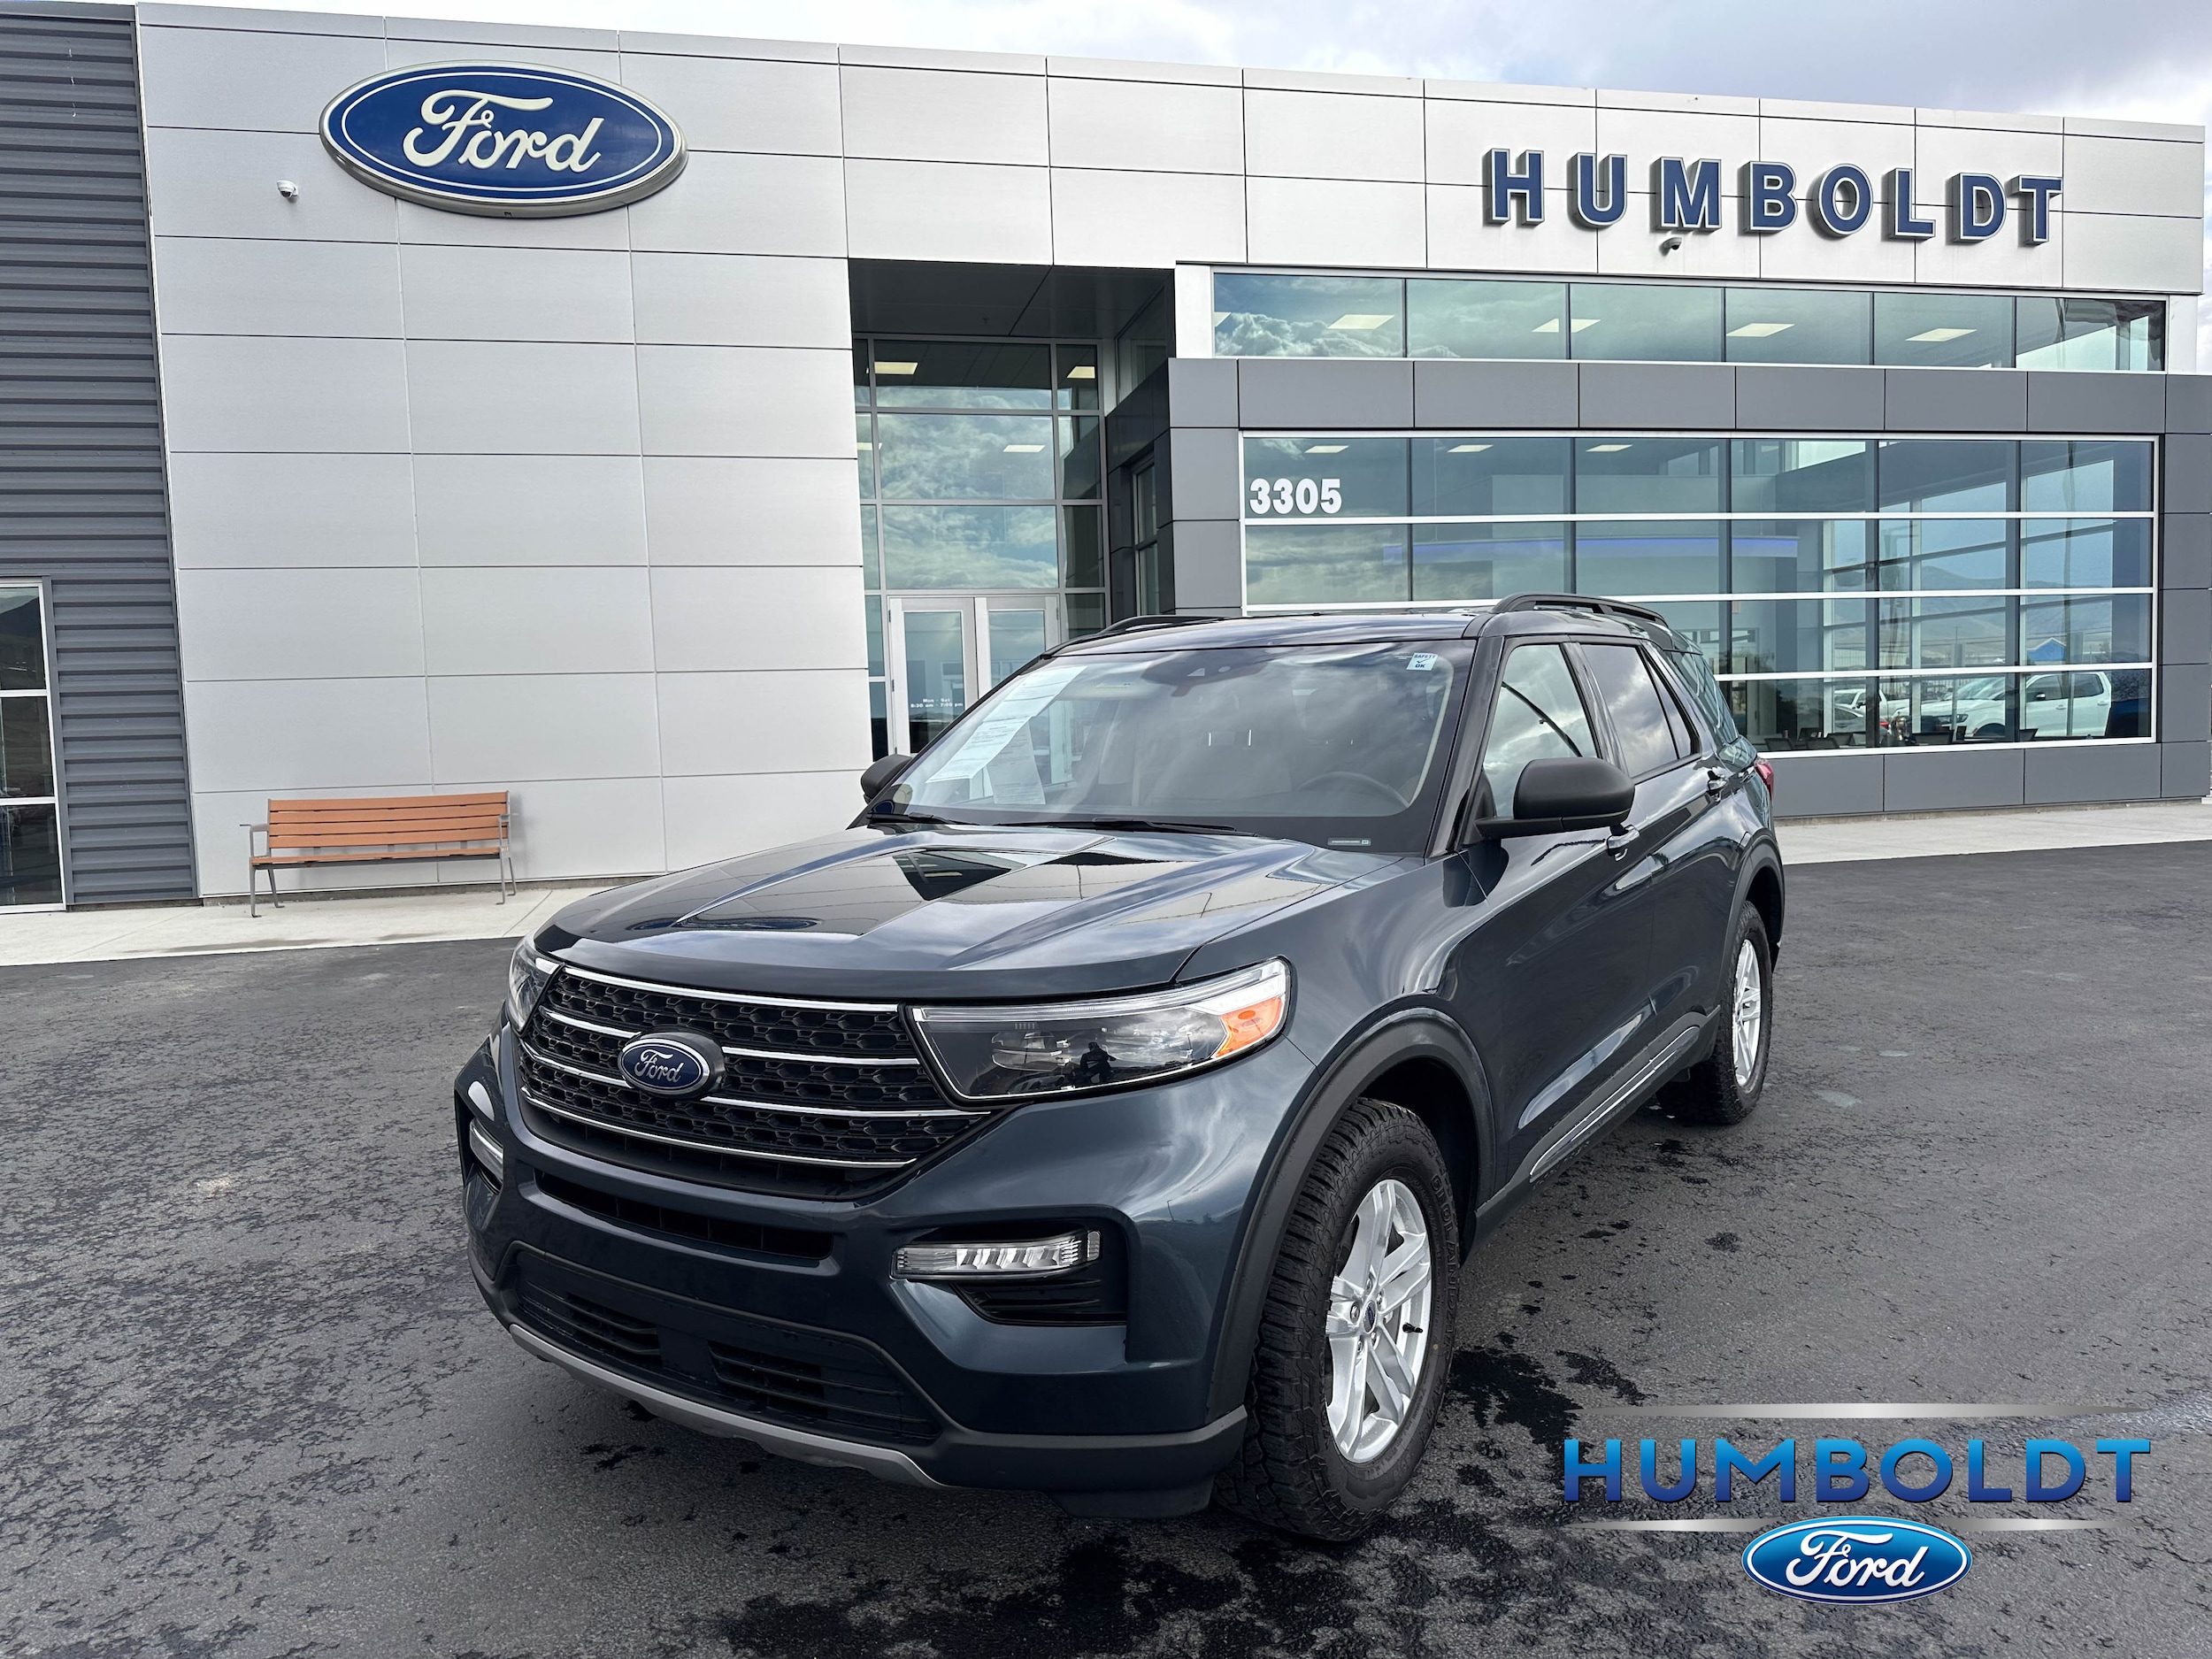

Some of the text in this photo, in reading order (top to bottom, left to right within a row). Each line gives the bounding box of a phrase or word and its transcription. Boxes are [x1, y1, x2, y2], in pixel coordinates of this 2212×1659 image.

[403, 89, 604, 173] Ford
[1486, 148, 2063, 244] HUMBOLDT
[1249, 478, 1342, 514] 3305
[634, 1048, 685, 1083] Ford
